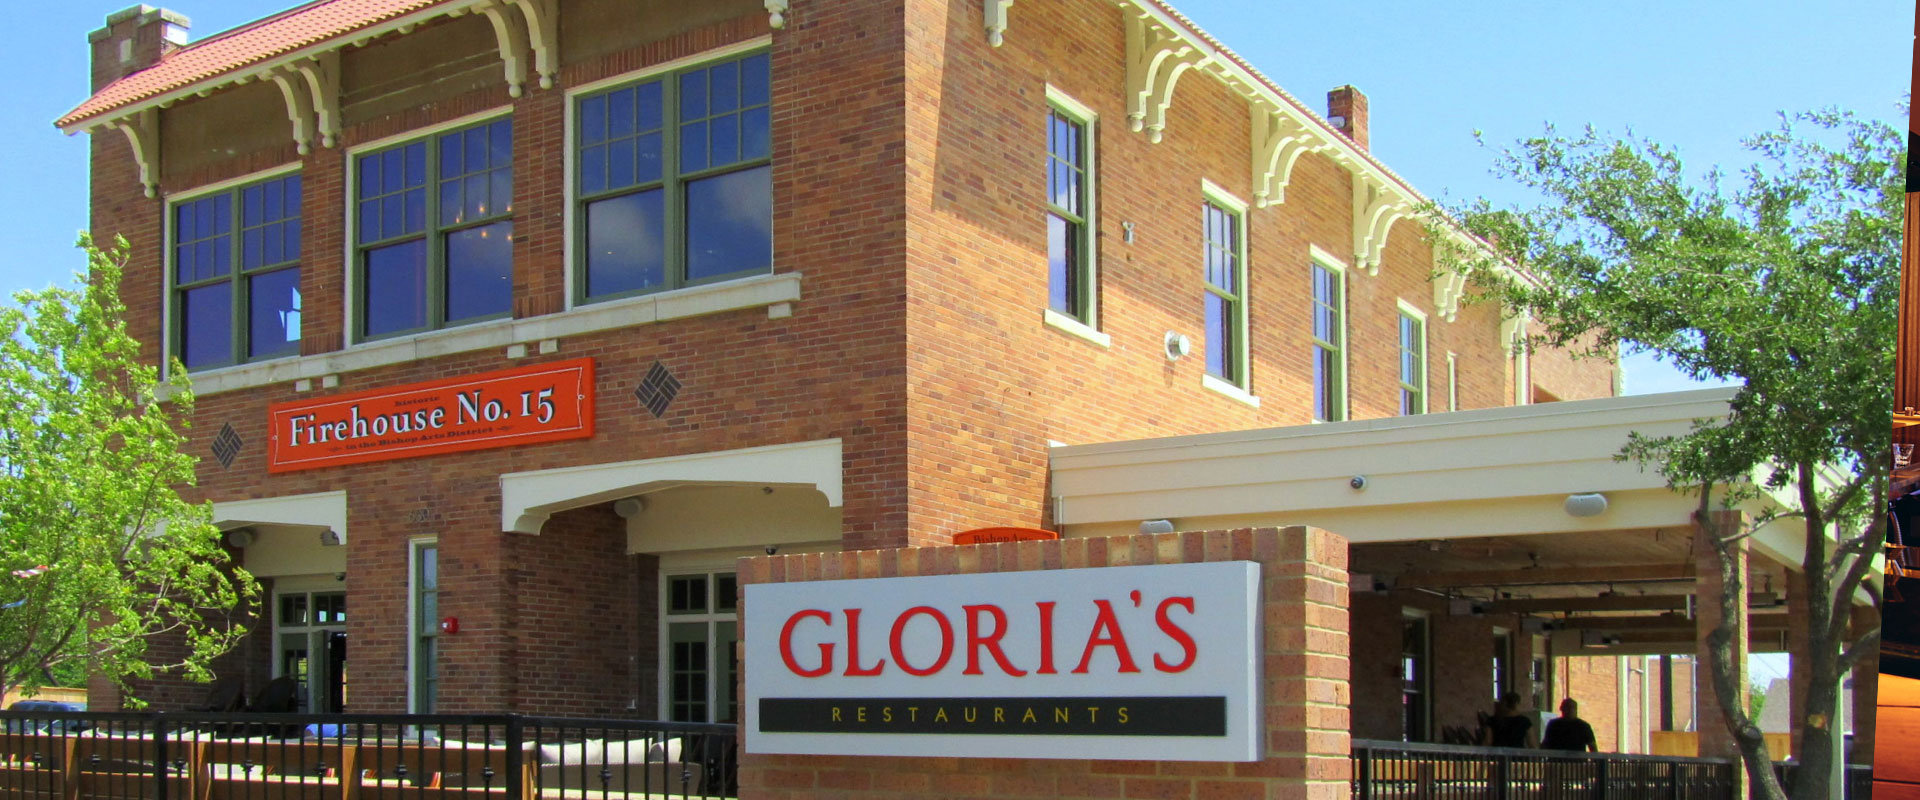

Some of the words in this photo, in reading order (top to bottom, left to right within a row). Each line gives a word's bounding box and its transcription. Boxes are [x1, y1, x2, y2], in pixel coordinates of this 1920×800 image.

[289, 404, 446, 446] Firehouse
[456, 389, 510, 425] No.
[519, 386, 555, 424] 15
[359, 440, 377, 449] the
[378, 434, 419, 447] Bishop
[421, 431, 446, 442] Arts
[446, 427, 493, 439] District
[779, 590, 1198, 678] GLORIA'S
[832, 706, 1130, 724] RESTAURANTS
